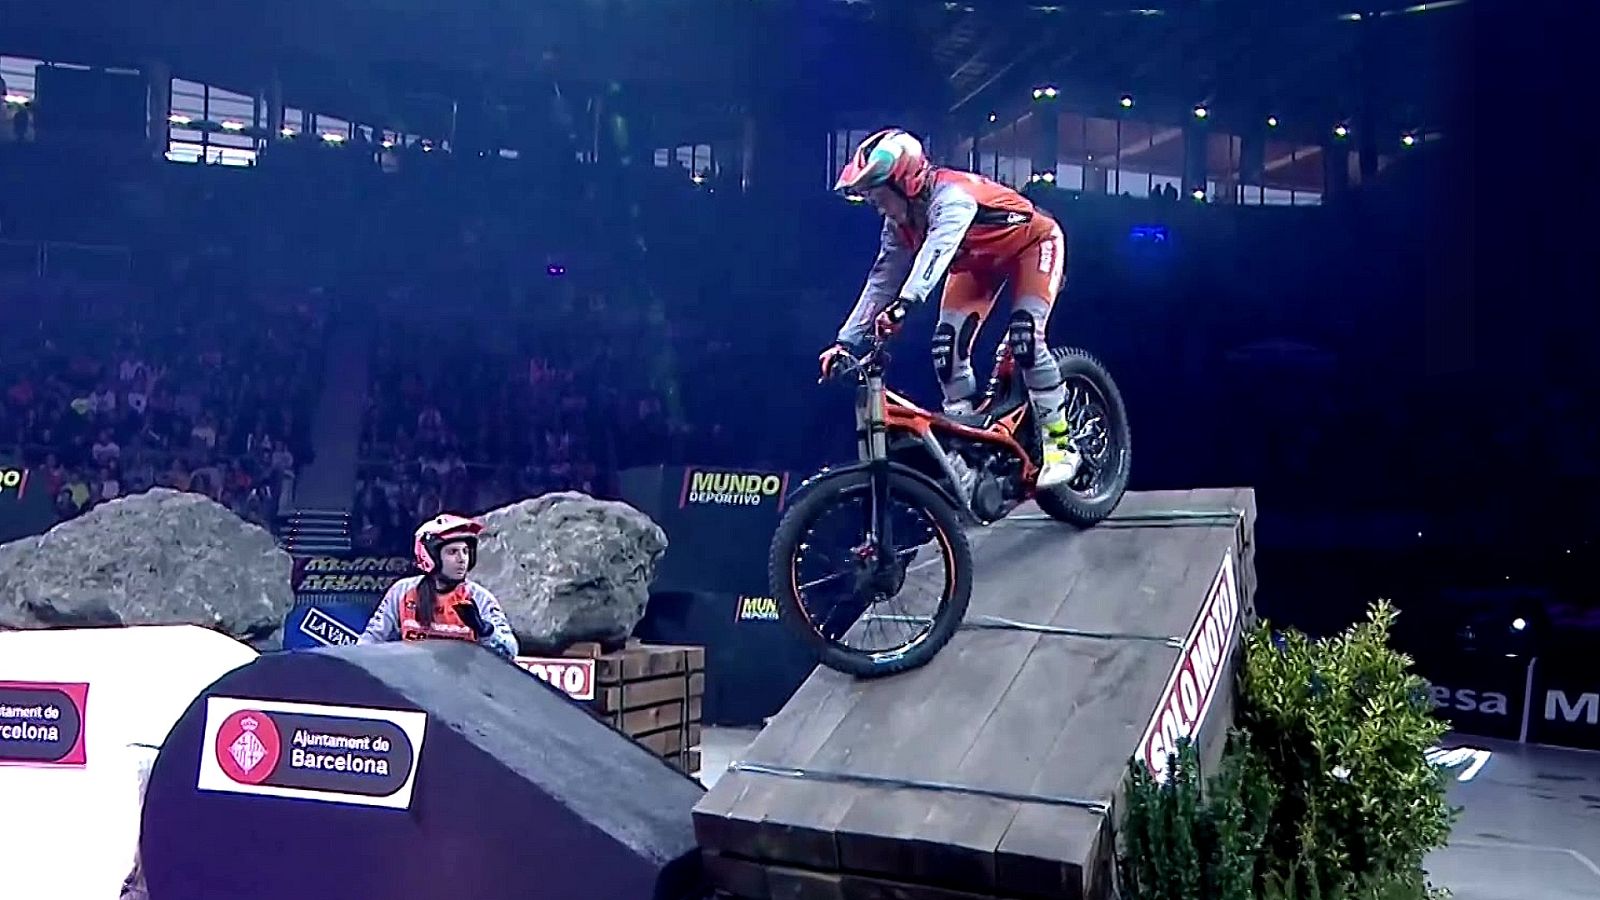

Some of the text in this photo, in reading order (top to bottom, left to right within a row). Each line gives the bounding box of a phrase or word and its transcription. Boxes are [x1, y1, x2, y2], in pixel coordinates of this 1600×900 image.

[692, 472, 780, 495] MUNDO
[689, 491, 761, 506] DEPORTIVO
[308, 615, 327, 635] LA
[1190, 580, 1233, 696] MOTO
[293, 729, 390, 752] Ajuntament de
[291, 748, 389, 776] Barcelona
